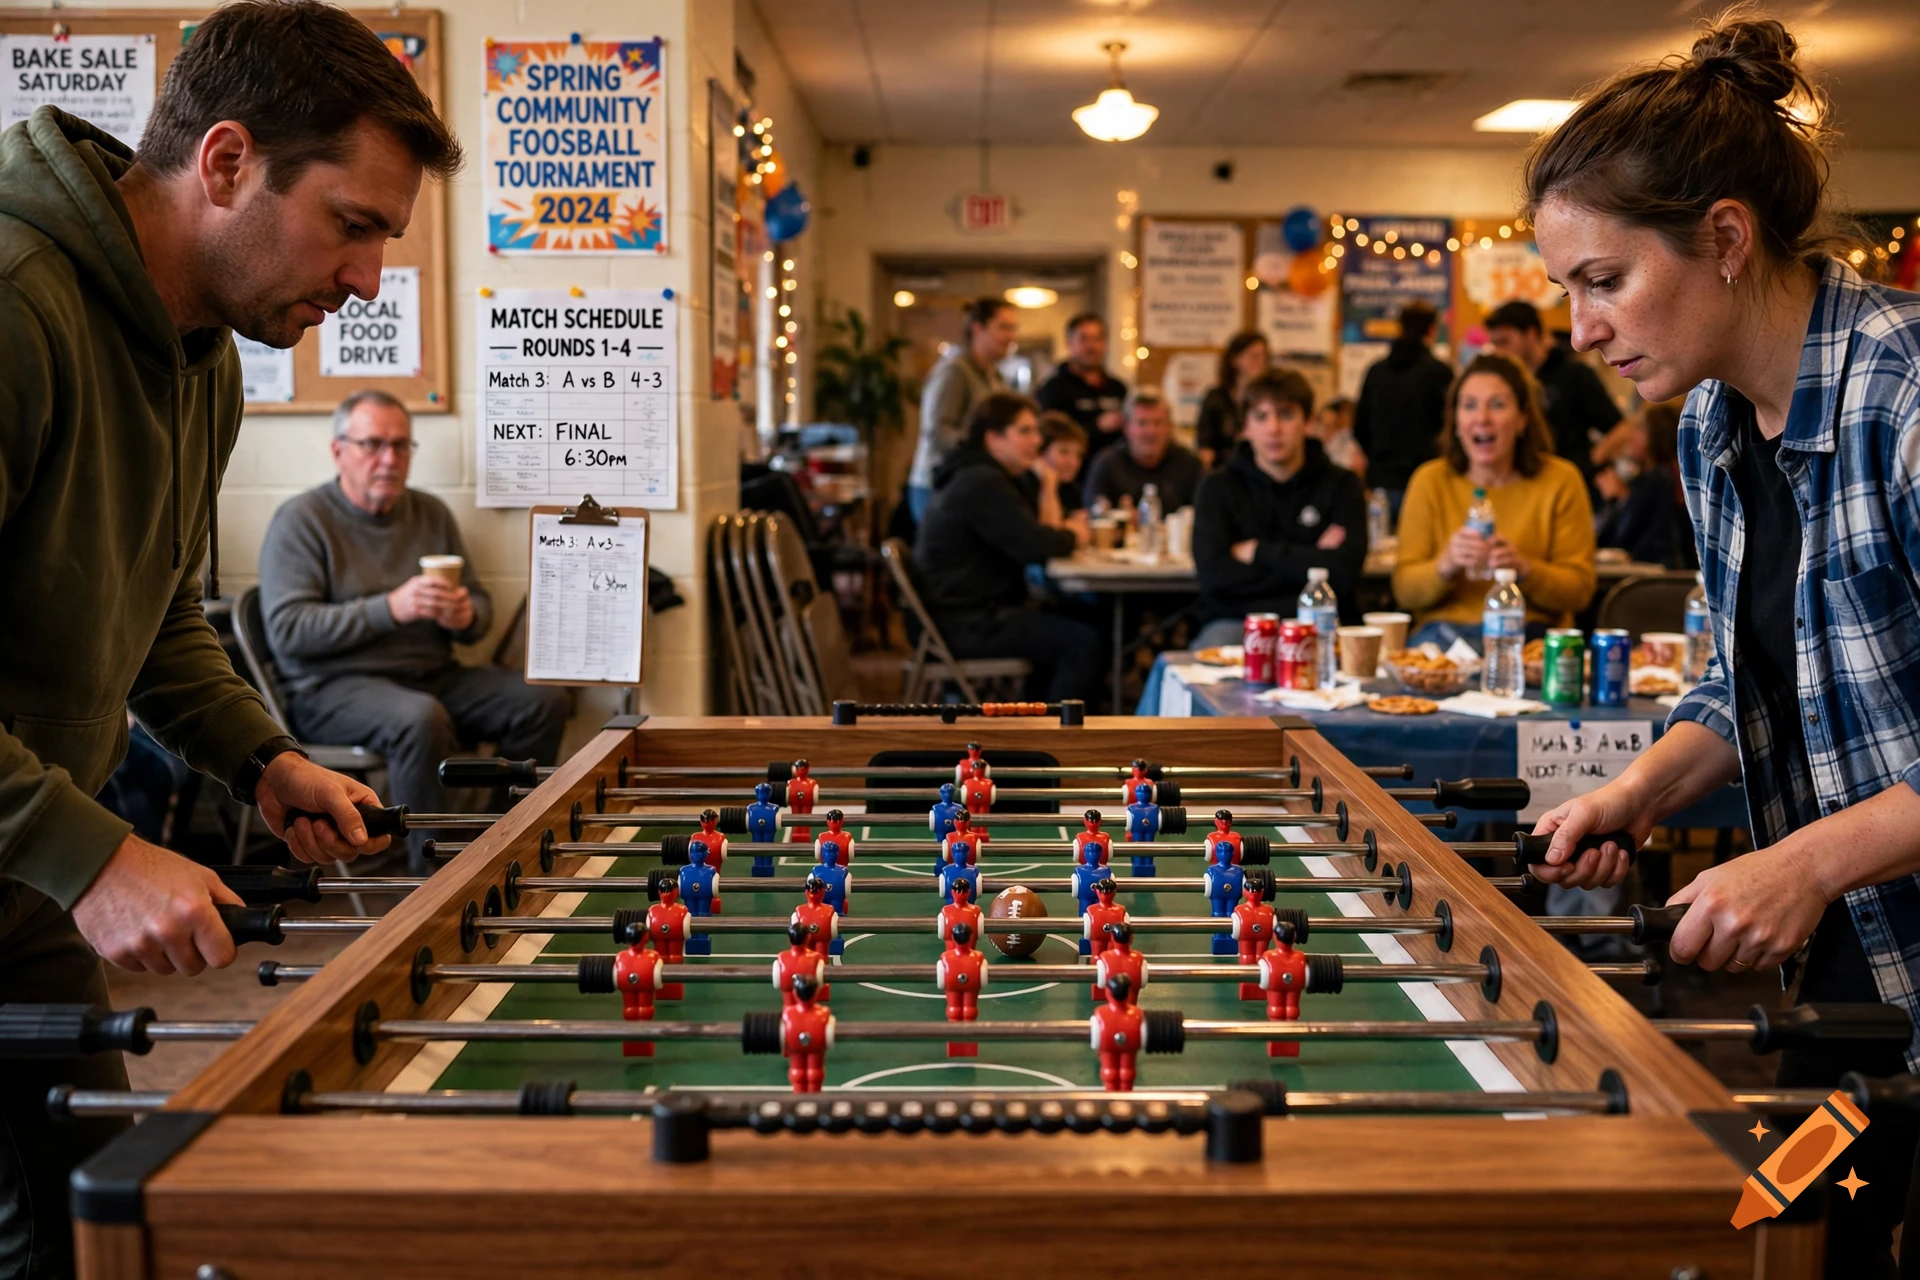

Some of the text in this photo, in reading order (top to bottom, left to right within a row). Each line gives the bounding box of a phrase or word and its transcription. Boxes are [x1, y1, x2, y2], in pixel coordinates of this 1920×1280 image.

[12, 47, 138, 70] BAKE SALE
[18, 72, 127, 92] SATURDAY
[526, 64, 621, 92] SPRING
[497, 96, 651, 124] COMMUNITY
[508, 128, 641, 156] FOOSBALL
[494, 160, 656, 188] TOURNAMENT
[539, 196, 613, 224] 2024
[338, 301, 402, 320] LOCAL
[491, 307, 664, 330] MATCH SCHEDULE
[339, 322, 398, 342] FOOD
[339, 345, 399, 365] DRIVE
[522, 337, 632, 358] ROUNDS 1-4
[489, 370, 663, 389] Match 3: A vs B 4-3
[493, 422, 612, 440] NEXT: FINAL
[1630, 732, 1643, 752] B
[1567, 761, 1608, 778] FNAL
